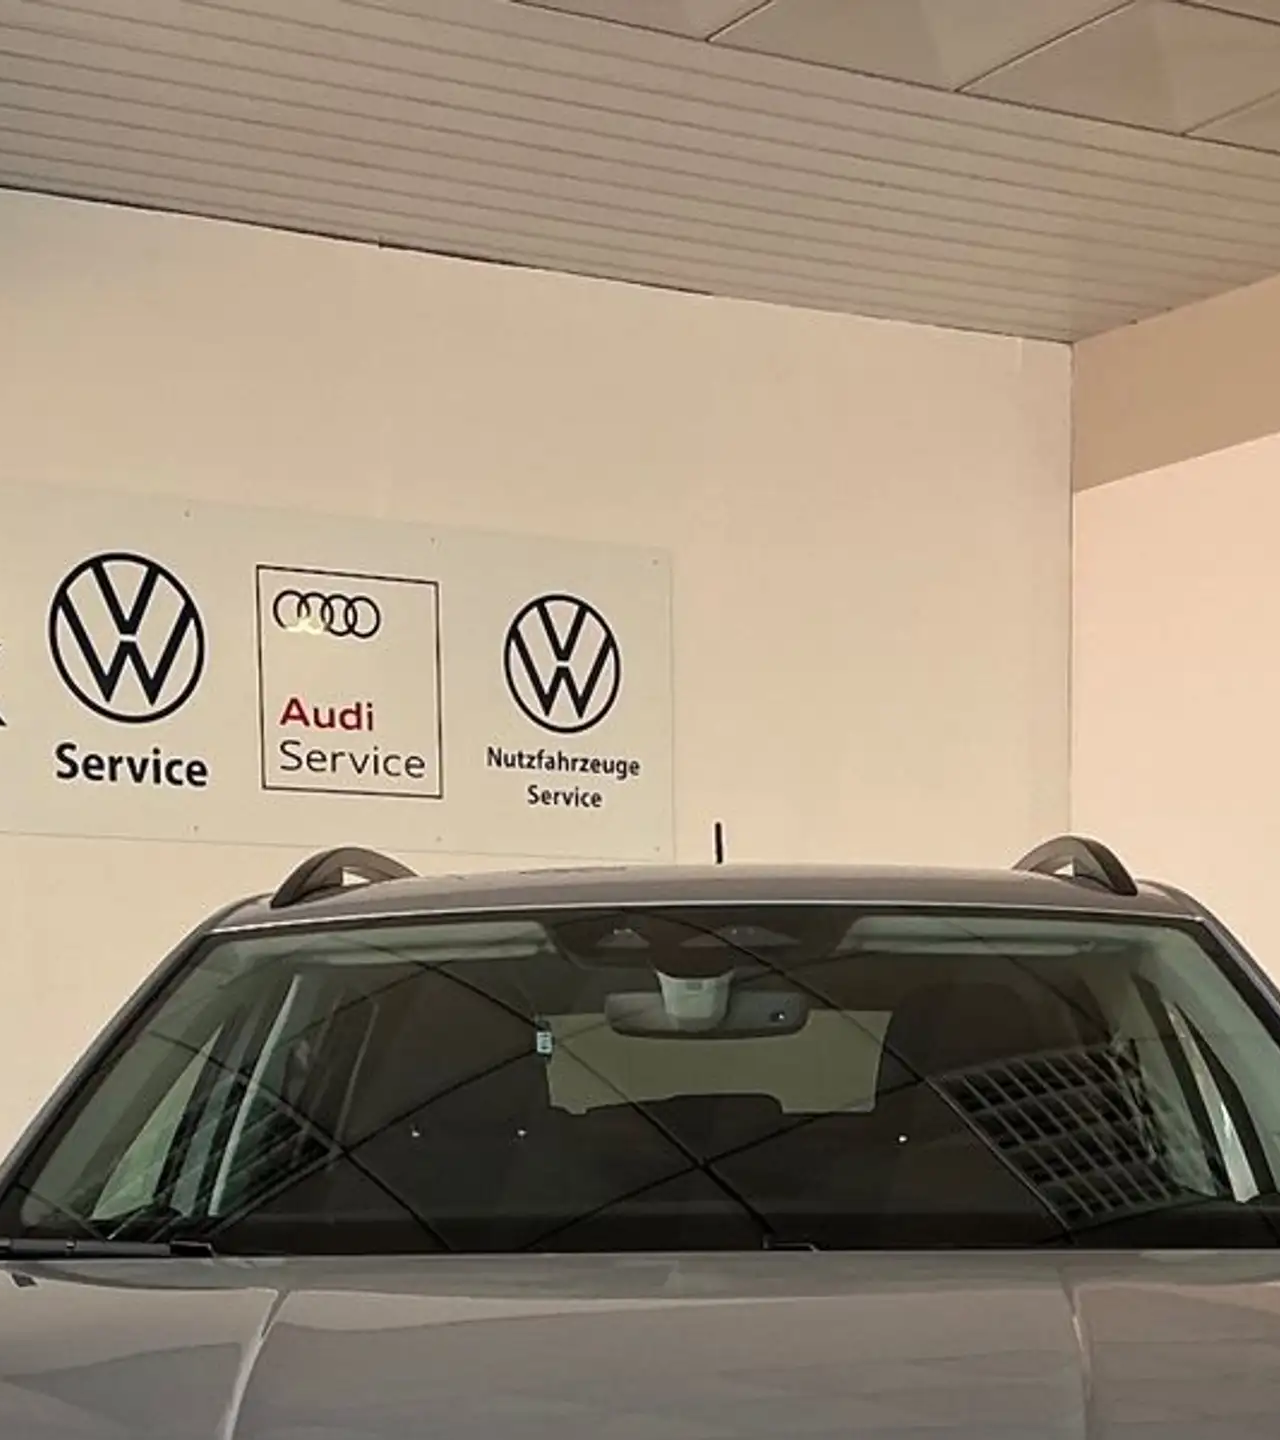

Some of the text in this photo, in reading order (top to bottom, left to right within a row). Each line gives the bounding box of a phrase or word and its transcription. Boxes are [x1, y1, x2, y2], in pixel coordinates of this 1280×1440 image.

[49, 552, 205, 724] VW
[504, 594, 621, 733] VW
[279, 697, 374, 732] Audi
[55, 742, 208, 787] Service
[279, 739, 426, 779] Service
[487, 746, 641, 779] Nutzfahrzeuge
[527, 784, 603, 808] Service
